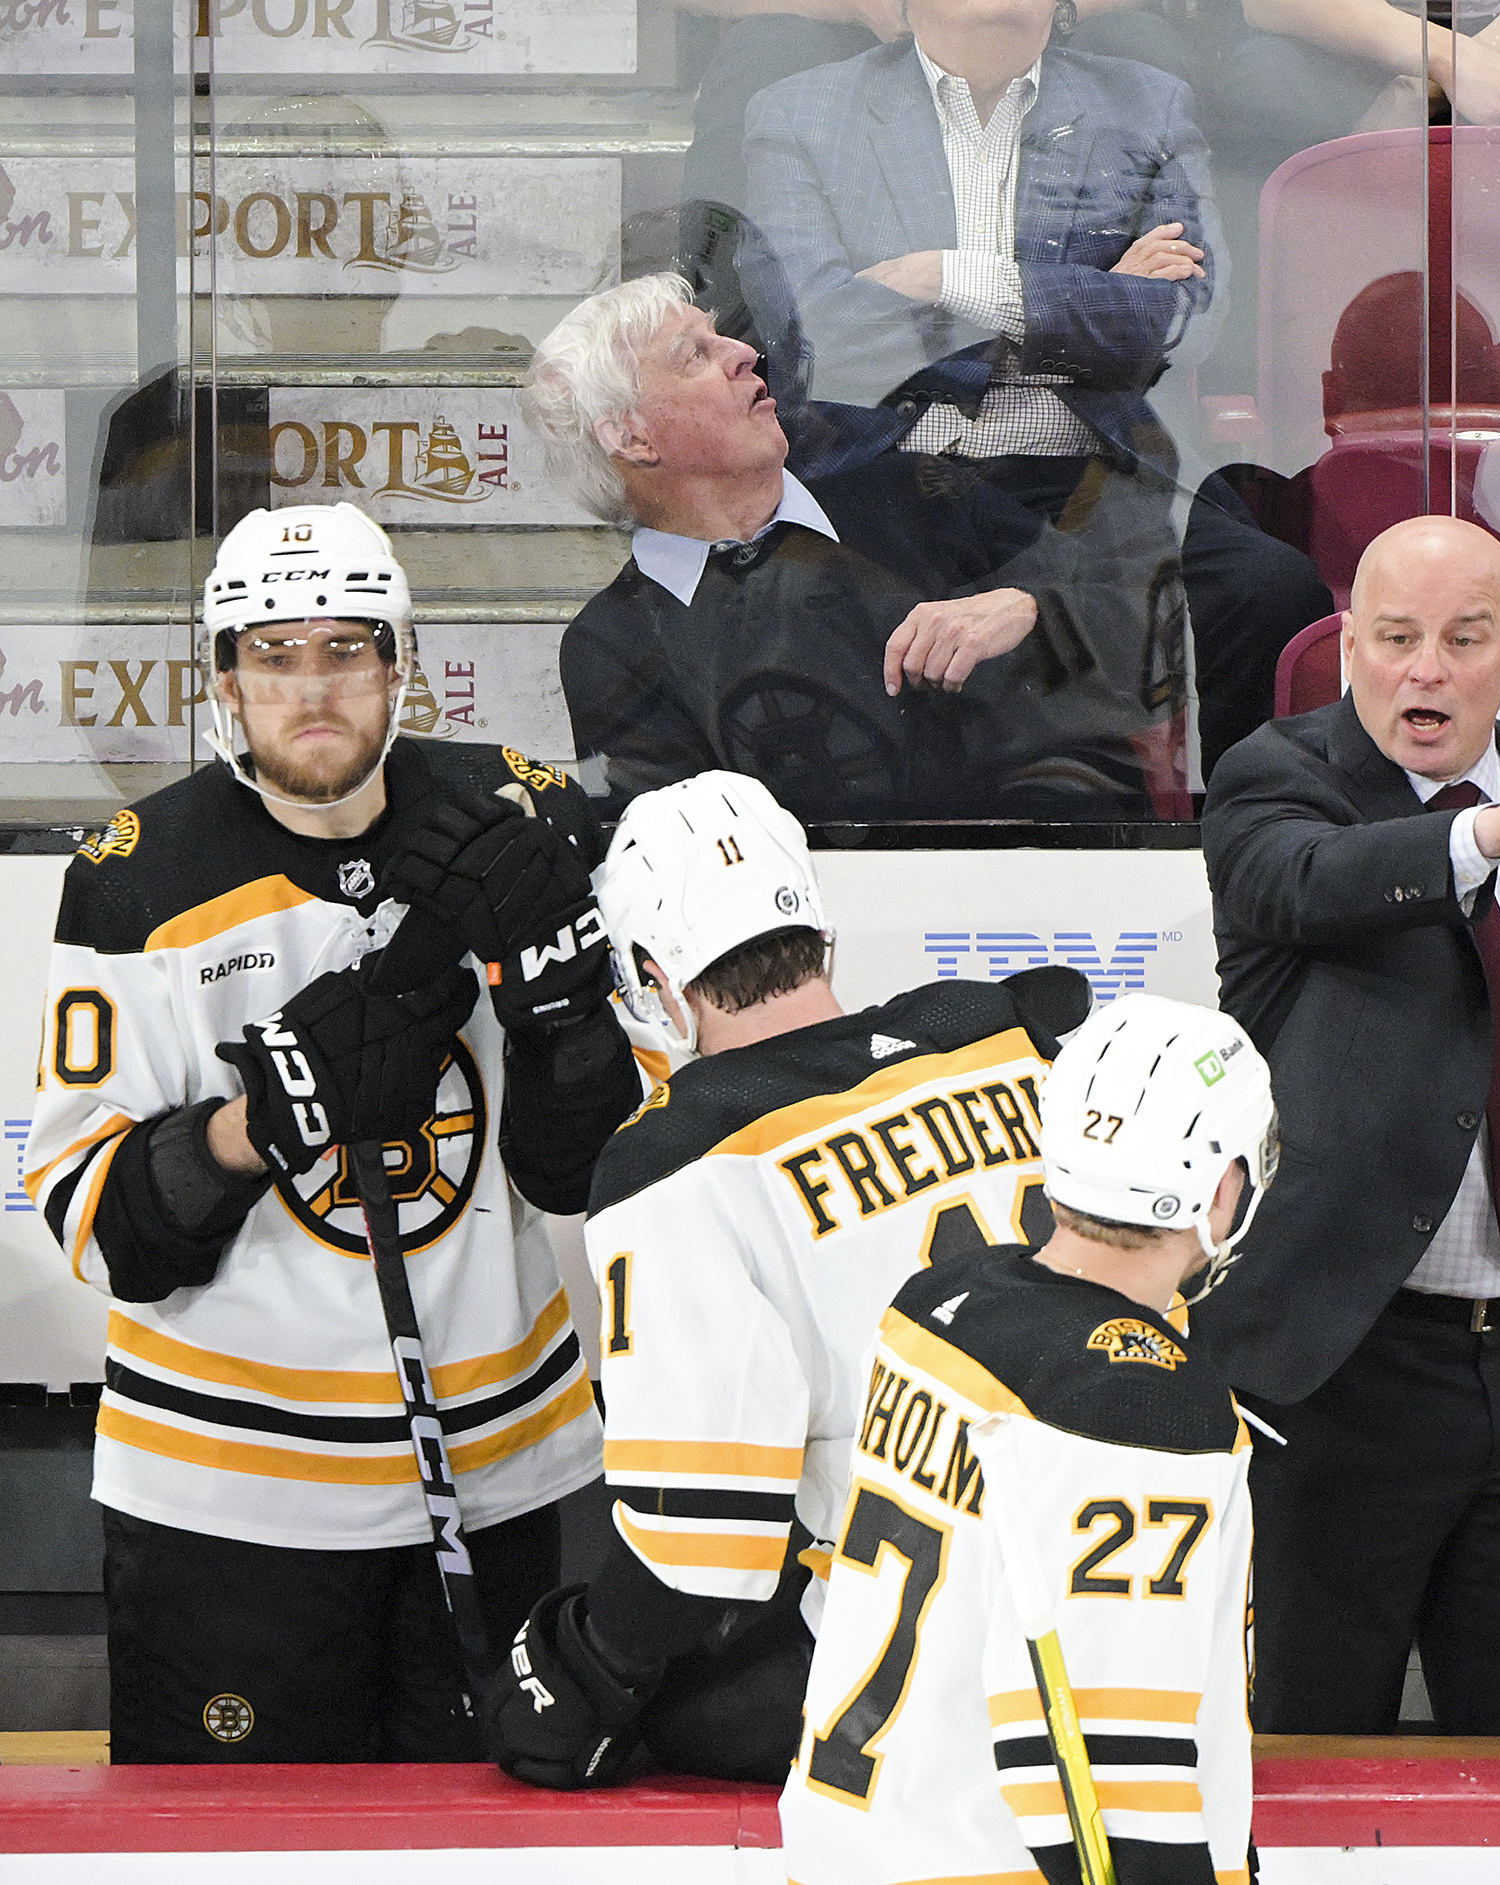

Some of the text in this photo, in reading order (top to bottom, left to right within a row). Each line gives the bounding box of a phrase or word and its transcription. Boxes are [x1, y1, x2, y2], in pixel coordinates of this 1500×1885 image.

[82, 0, 400, 46] EPORT
[447, 193, 477, 260] ALE
[477, 422, 508, 490] ALE
[261, 568, 332, 584] CCM
[445, 660, 475, 727] ALE
[716, 834, 746, 868] 11
[519, 906, 609, 983] CM
[1162, 931, 1184, 942] MD
[37, 986, 118, 1091] 0
[1219, 1037, 1246, 1063] Bank
[252, 1010, 332, 1148] CCM
[776, 1074, 1046, 1241] FREDERI
[1082, 1108, 1124, 1145] 27
[598, 1250, 635, 1359] 1
[392, 1335, 474, 1576] CCM
[859, 1355, 988, 1520] HOLM
[1064, 1494, 1215, 1602] 27
[805, 1476, 954, 1813] 7
